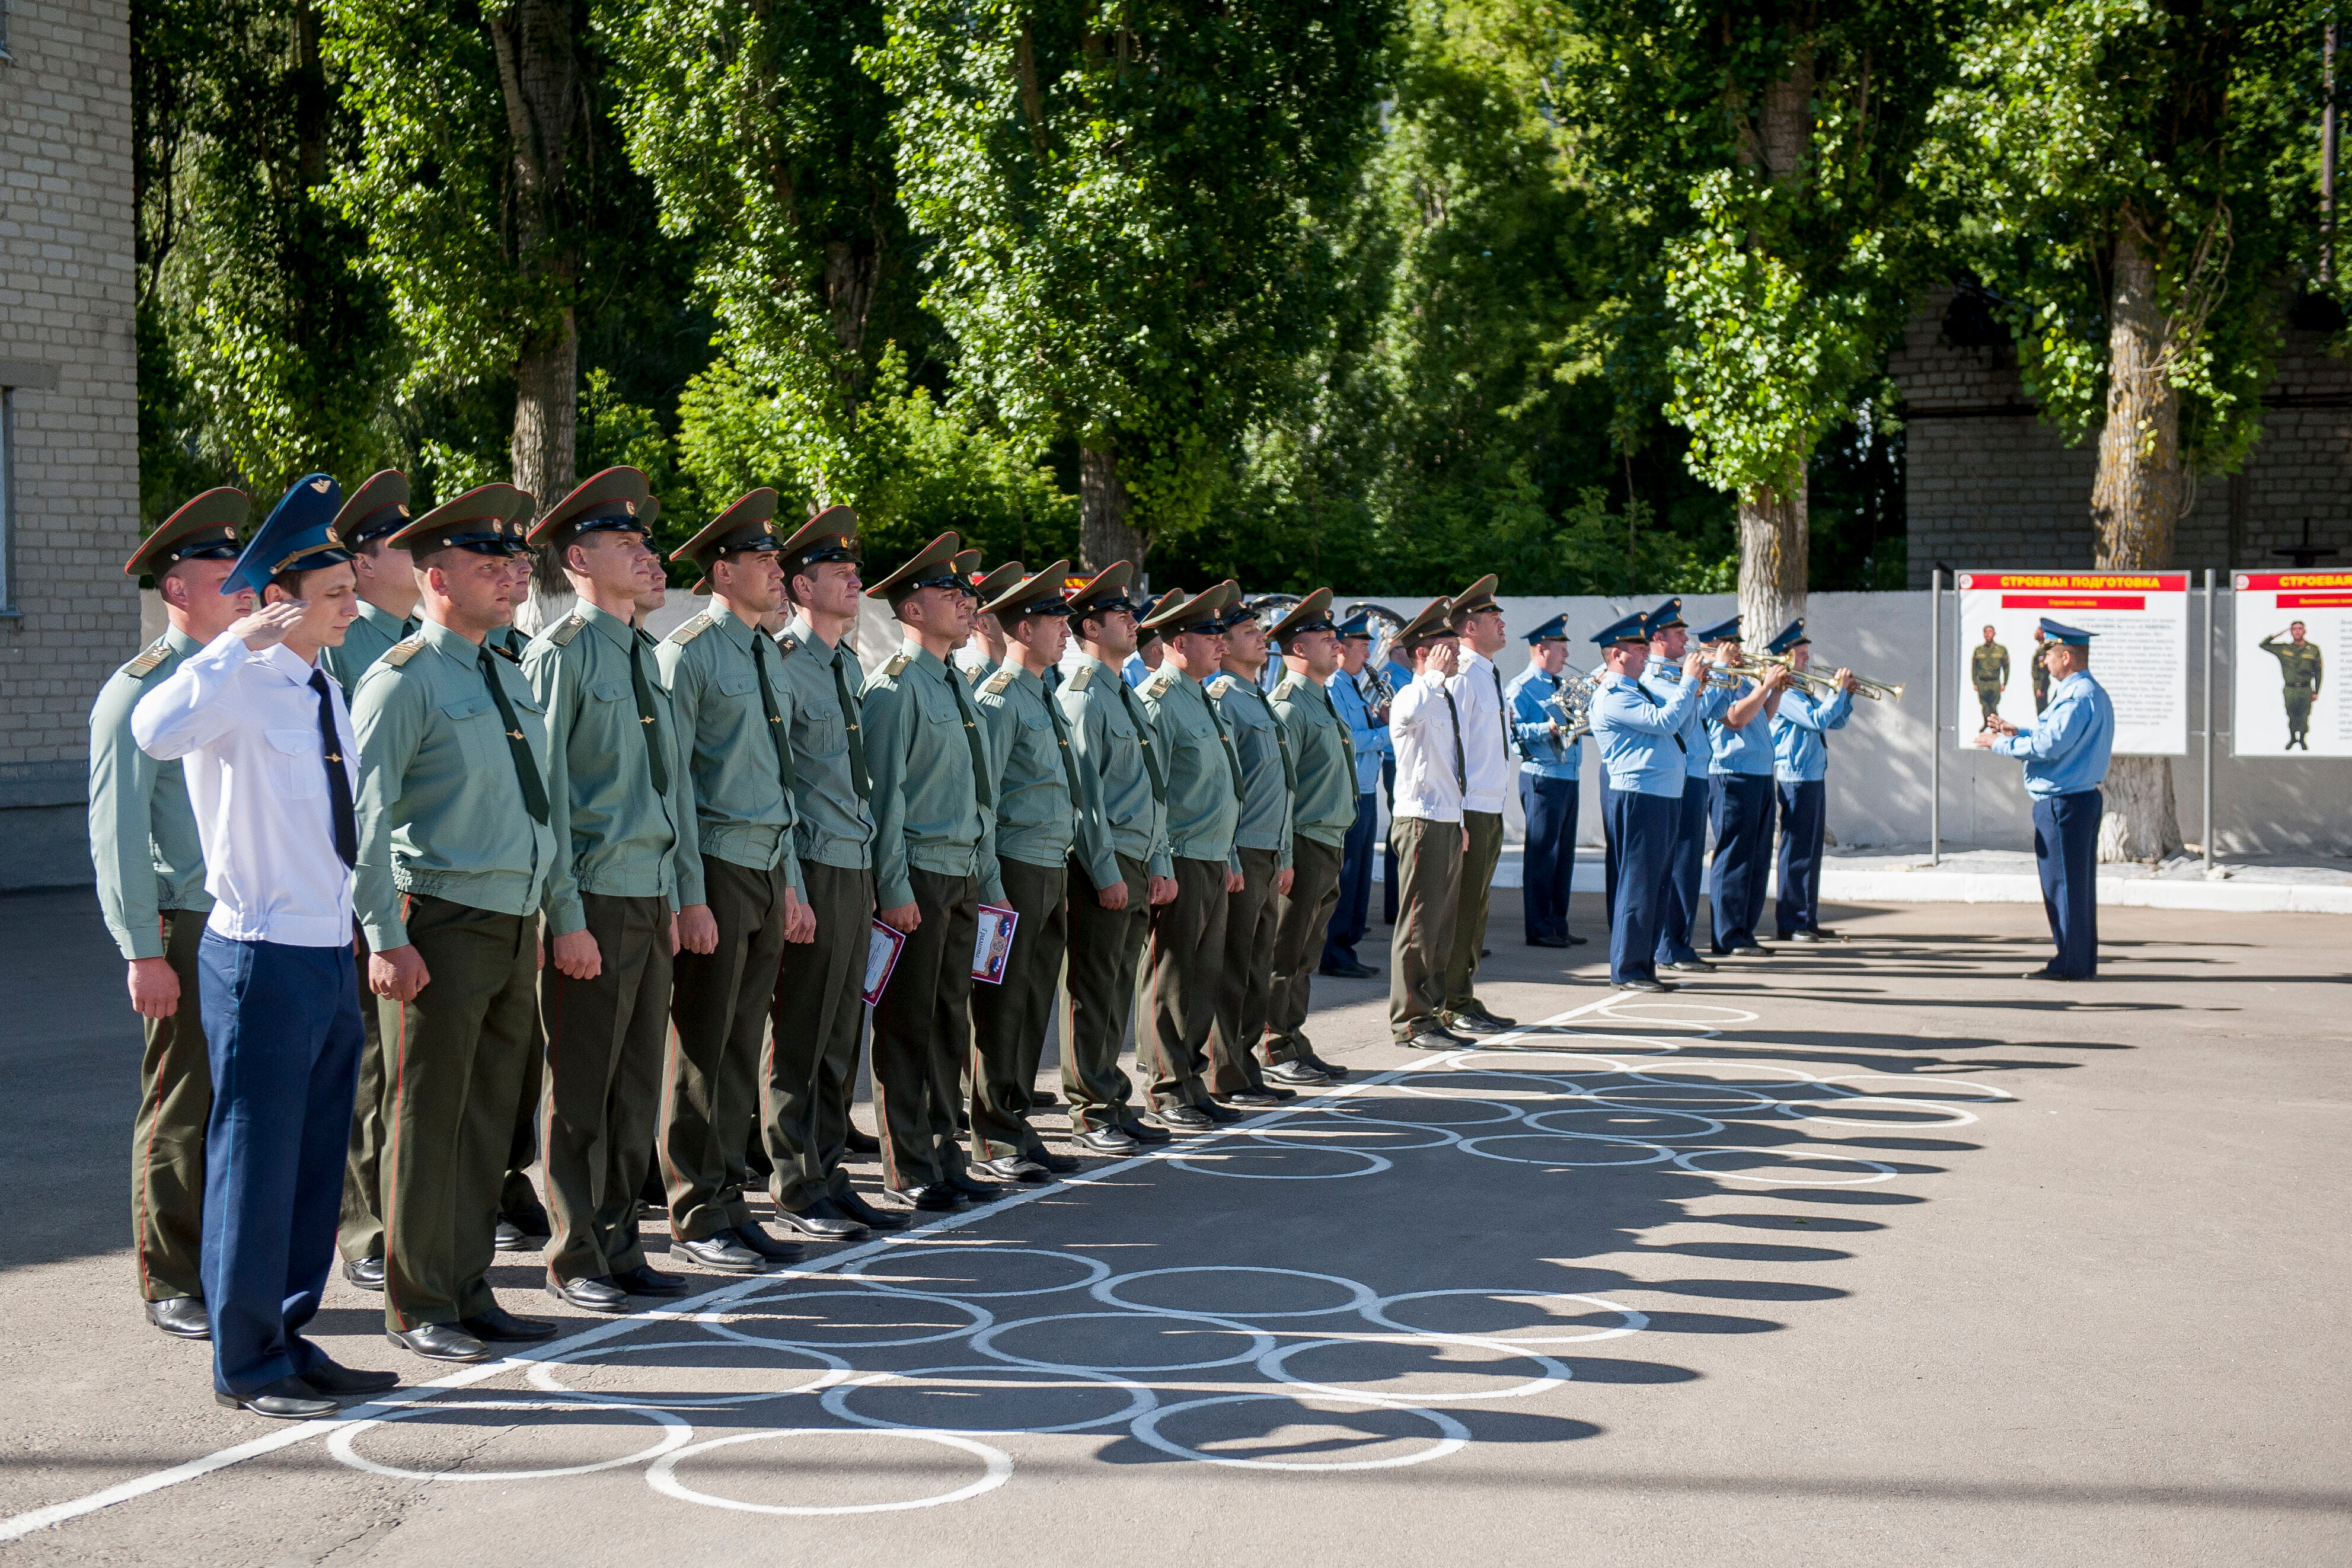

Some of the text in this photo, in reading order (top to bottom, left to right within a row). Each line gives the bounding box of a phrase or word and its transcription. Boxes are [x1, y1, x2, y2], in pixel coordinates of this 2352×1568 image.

[2000, 576, 2160, 589] СТРОЕВАЯ ПОДГОТОВКА
[976, 928, 988, 959] Грамота
